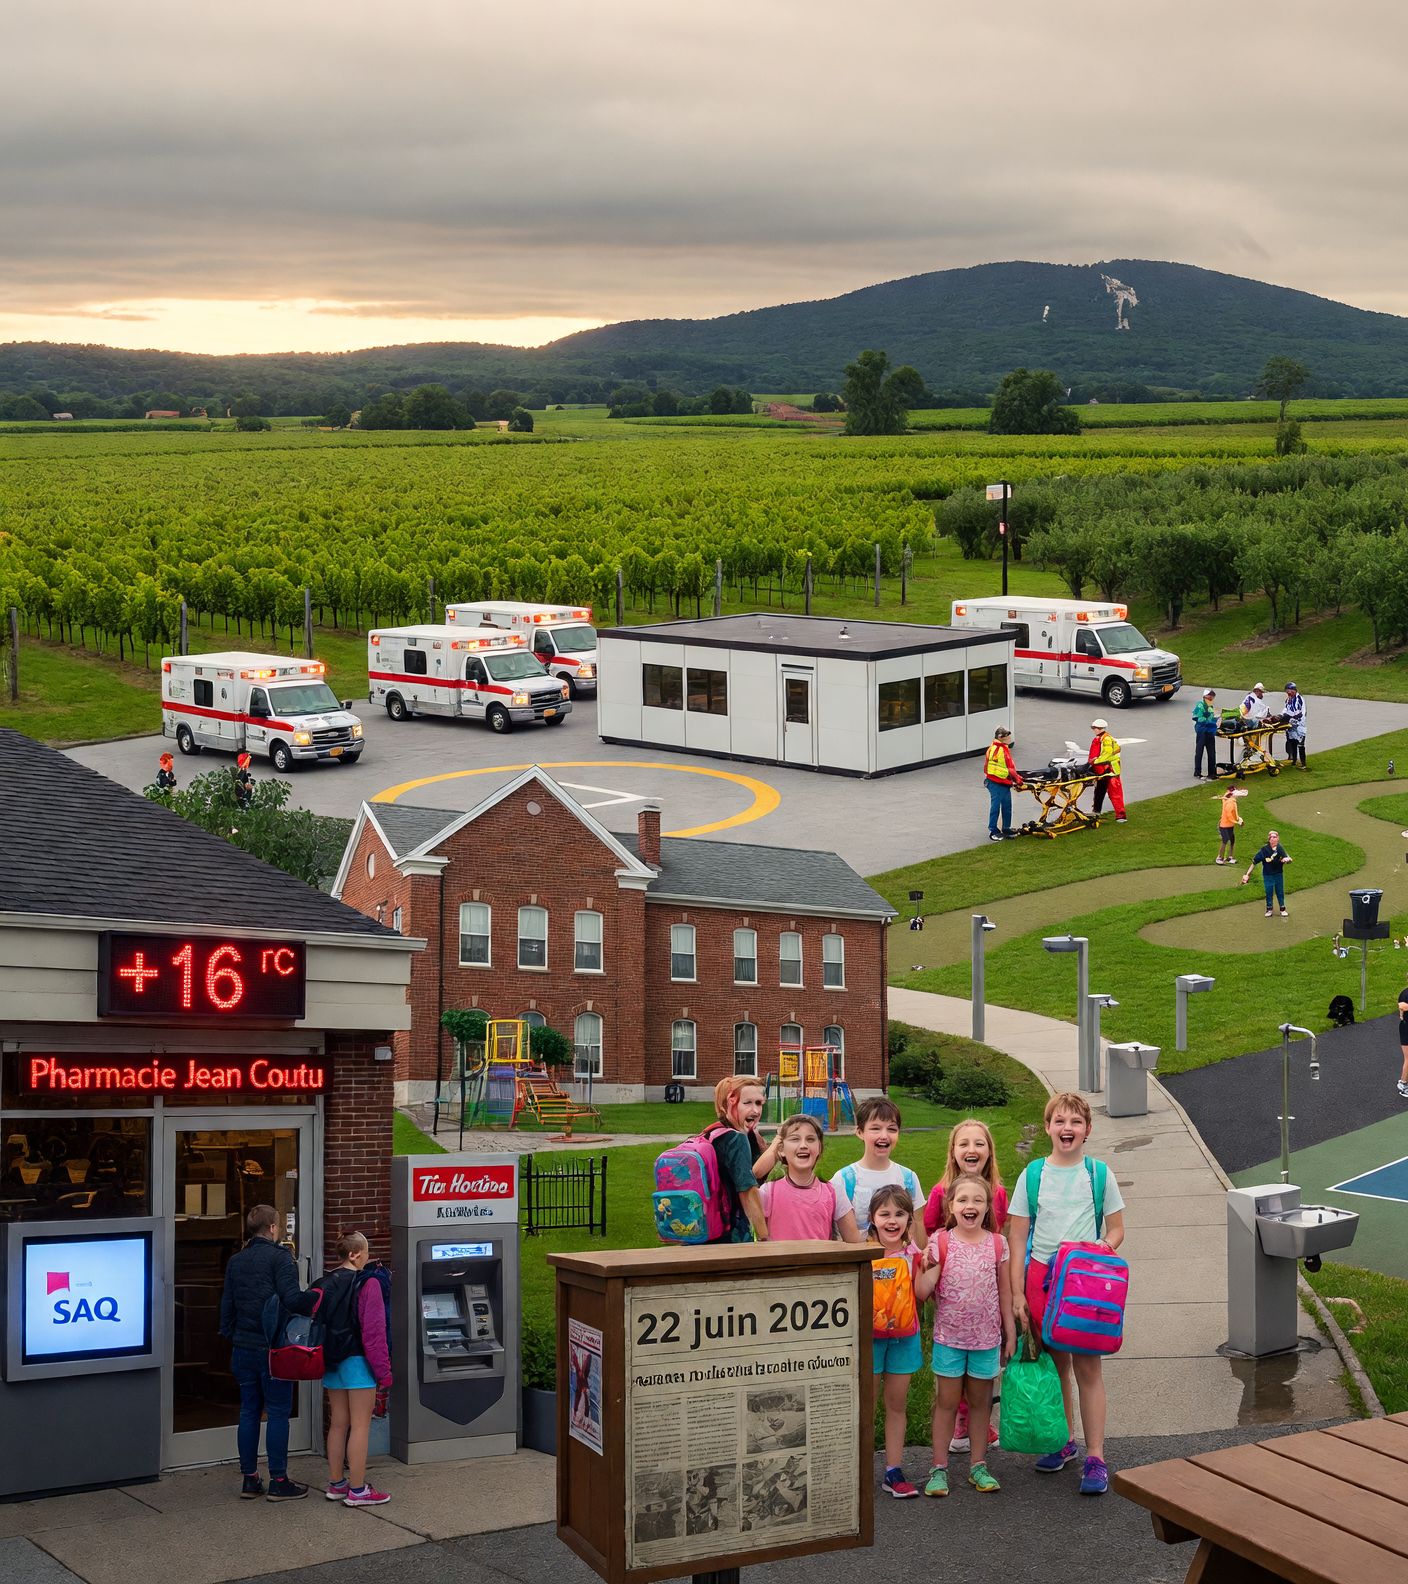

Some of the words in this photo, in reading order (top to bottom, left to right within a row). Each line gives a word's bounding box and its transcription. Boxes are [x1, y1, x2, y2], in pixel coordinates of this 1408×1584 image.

[30, 1057, 176, 1089] Pharmacie
[183, 1059, 242, 1089] Jean
[249, 1059, 325, 1089] Coutu
[52, 1296, 121, 1325] SAQ
[636, 1311, 681, 1346] 22
[689, 1305, 757, 1350] juin
[768, 1297, 850, 1334] 2026
